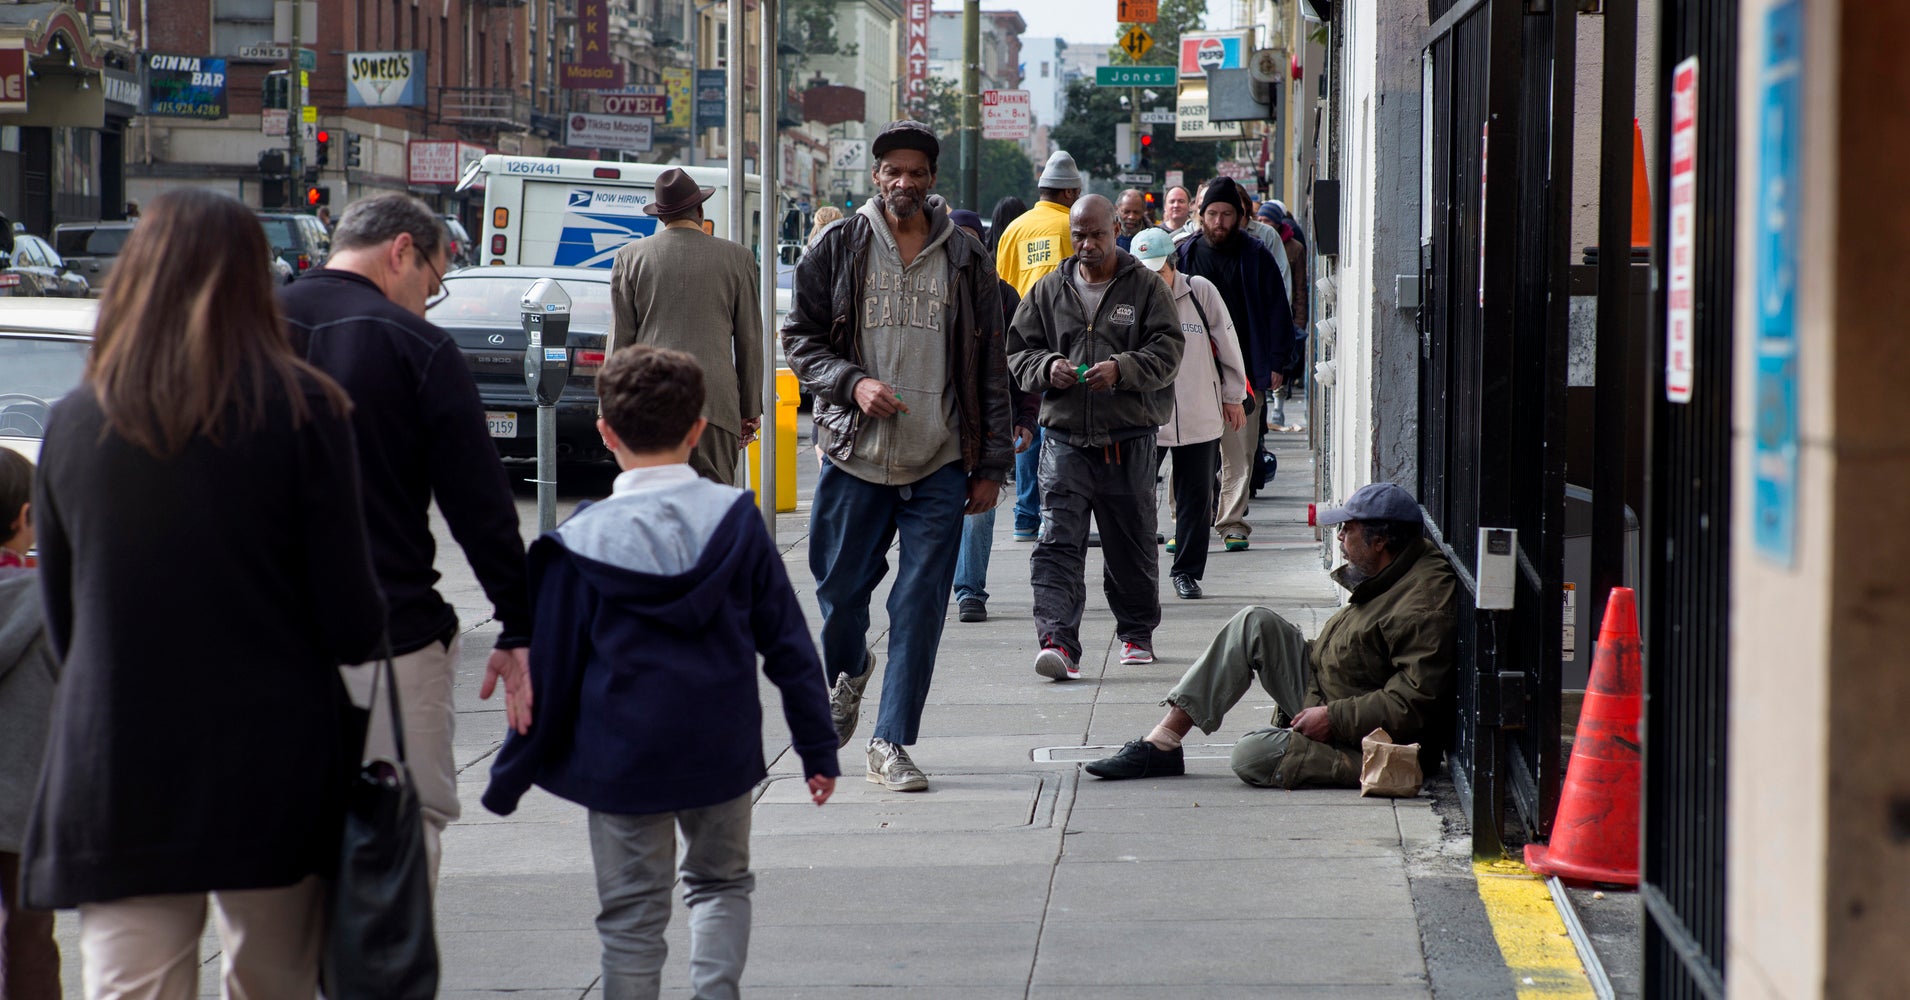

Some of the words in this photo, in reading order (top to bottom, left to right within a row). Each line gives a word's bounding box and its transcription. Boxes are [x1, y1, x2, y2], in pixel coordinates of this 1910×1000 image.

[243, 48, 284, 57] JONES
[911, 0, 926, 111] ENATO
[1199, 50, 1223, 60] PEPSI
[150, 55, 201, 72] CINNA
[191, 72, 224, 87] BAR
[567, 66, 614, 79] Masala
[1111, 72, 1161, 81] Jones
[600, 96, 663, 114] OTEL
[985, 92, 997, 104] NO
[1179, 105, 1208, 116] GROCERY
[588, 118, 611, 131] Tikka
[613, 121, 649, 133] Masala
[1181, 121, 1205, 131] BEER
[837, 143, 862, 167] CAFE
[506, 161, 562, 175] 1267441
[595, 193, 617, 203] NOW
[617, 195, 647, 205] HIRING
[1027, 240, 1050, 253] GLIDE
[1027, 250, 1051, 265] STAFF
[864, 272, 950, 305] MERICA
[863, 296, 942, 332] EAGLE
[1181, 323, 1203, 334] CISCO
[489, 420, 514, 434] P159
